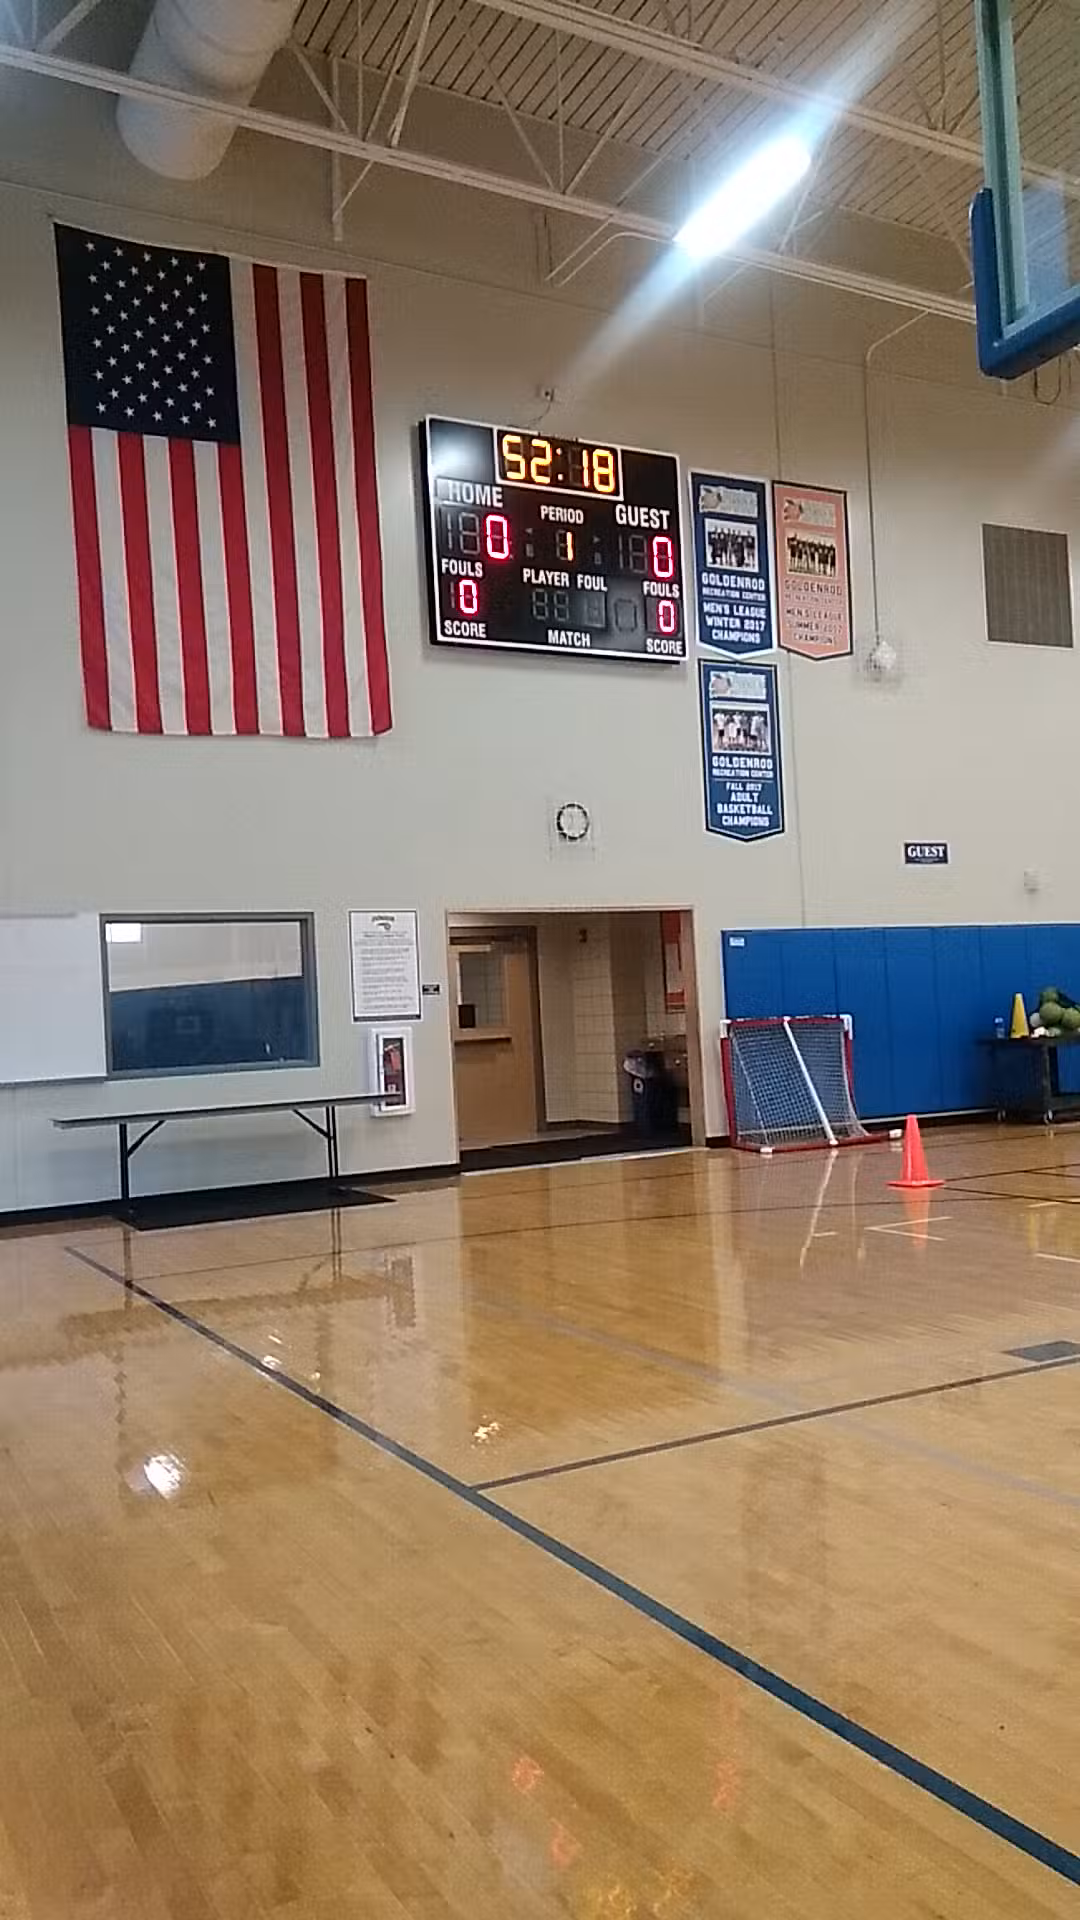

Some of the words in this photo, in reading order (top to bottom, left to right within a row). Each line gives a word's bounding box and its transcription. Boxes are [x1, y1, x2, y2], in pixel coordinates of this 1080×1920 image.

[502, 434, 615, 493] 52:18
[448, 480, 503, 508] HOME
[541, 505, 584, 524] PERIOD
[615, 504, 670, 530] GUEST
[442, 559, 483, 577] FOULS
[523, 568, 569, 588] PLAYER
[577, 574, 607, 591] FOUL
[702, 572, 765, 591] GOLDENROD
[643, 581, 679, 598] FOULS
[733, 605, 766, 619] LEAGUE
[444, 620, 486, 638] SCORE
[705, 615, 741, 629] WINTER
[547, 629, 590, 647] MATCH
[712, 629, 760, 644] CHAMPIONS
[646, 638, 682, 655] SCORE
[712, 756, 773, 770] GOLDENROD
[726, 782, 744, 791] FALL
[730, 791, 759, 803] ADULT
[717, 803, 773, 815] BASKETBALL
[722, 815, 769, 827] CHAMPIONS
[907, 845, 945, 857] GUEST
